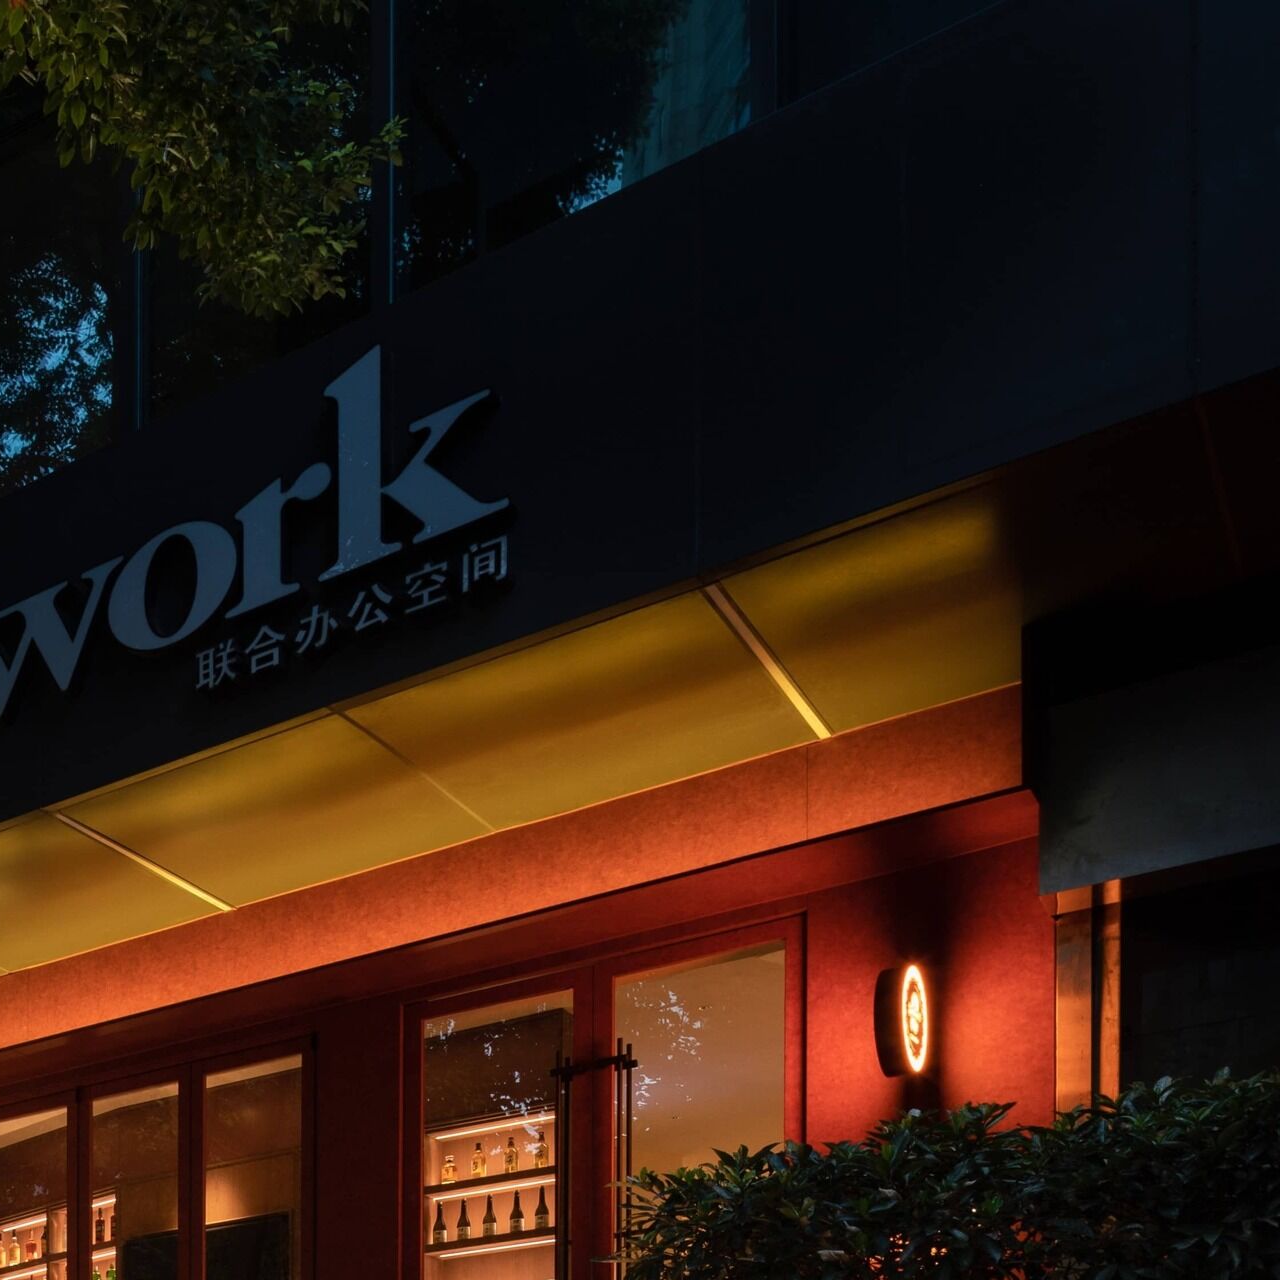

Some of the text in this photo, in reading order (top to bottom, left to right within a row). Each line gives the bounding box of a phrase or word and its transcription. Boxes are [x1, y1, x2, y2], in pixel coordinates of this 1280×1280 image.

[195, 535, 508, 692] 联合办公空间
